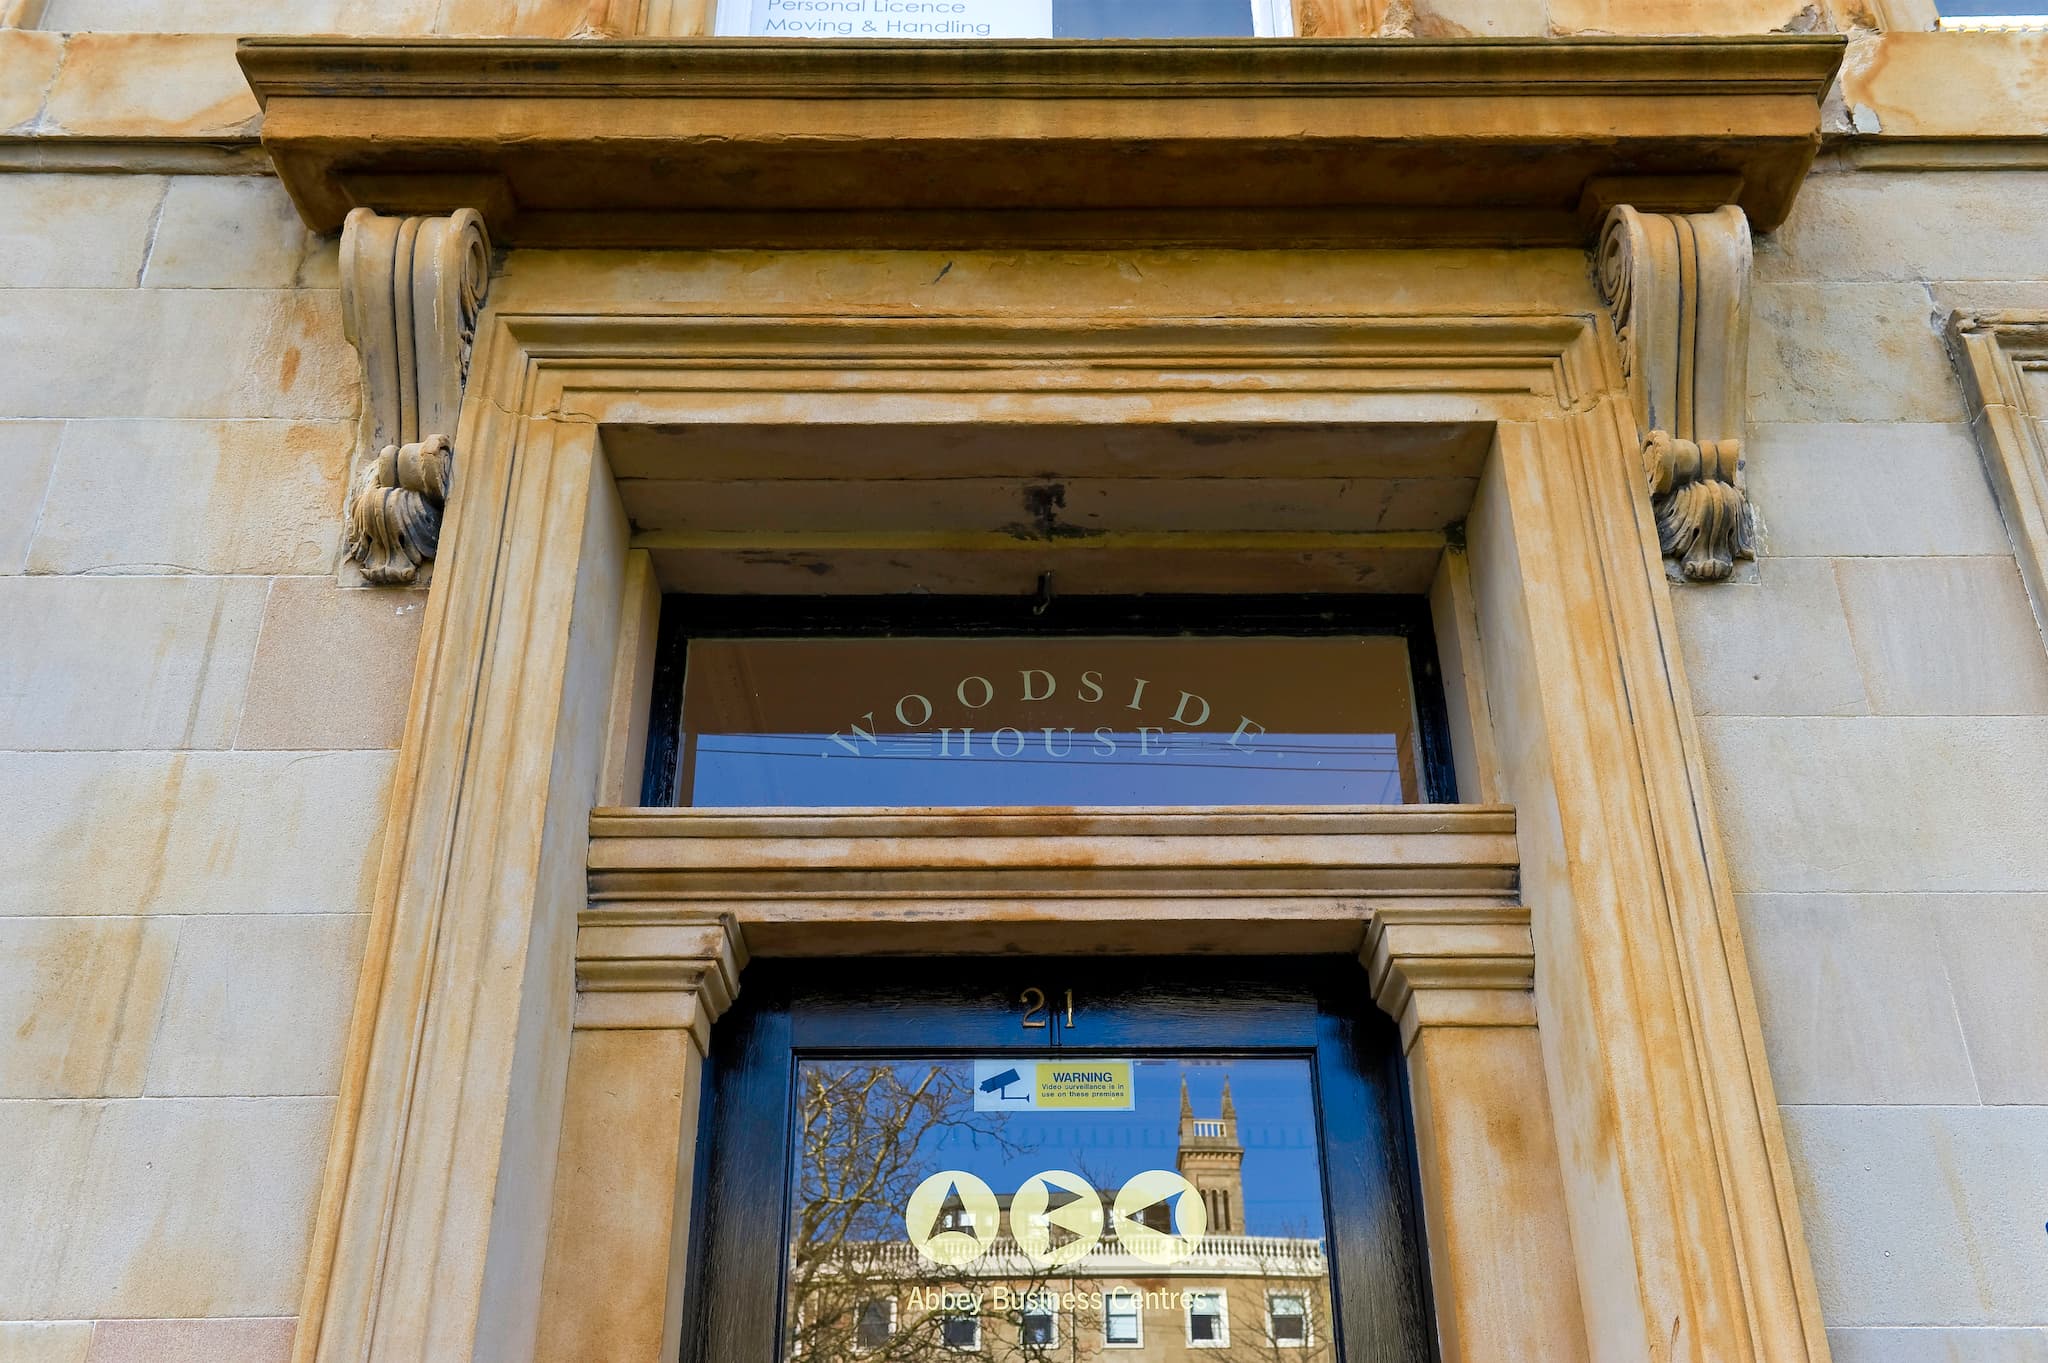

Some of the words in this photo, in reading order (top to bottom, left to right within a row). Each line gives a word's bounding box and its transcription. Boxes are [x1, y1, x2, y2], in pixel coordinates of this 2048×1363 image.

[768, 0, 864, 12] Personal
[874, 0, 965, 13] Licence
[765, 18, 852, 34] Moving
[862, 20, 877, 32] &
[887, 20, 990, 36] Handling
[825, 669, 1267, 758] WOODSIDE
[938, 726, 1168, 758] HOUSE
[1020, 987, 1075, 1028] 21
[1053, 1072, 1113, 1083] WARNING
[1069, 1090, 1089, 1098] these
[1092, 1091, 1124, 1099] premises
[907, 1286, 985, 1316] Abbey
[994, 1286, 1102, 1312] Business
[1112, 1286, 1207, 1312] Centres
